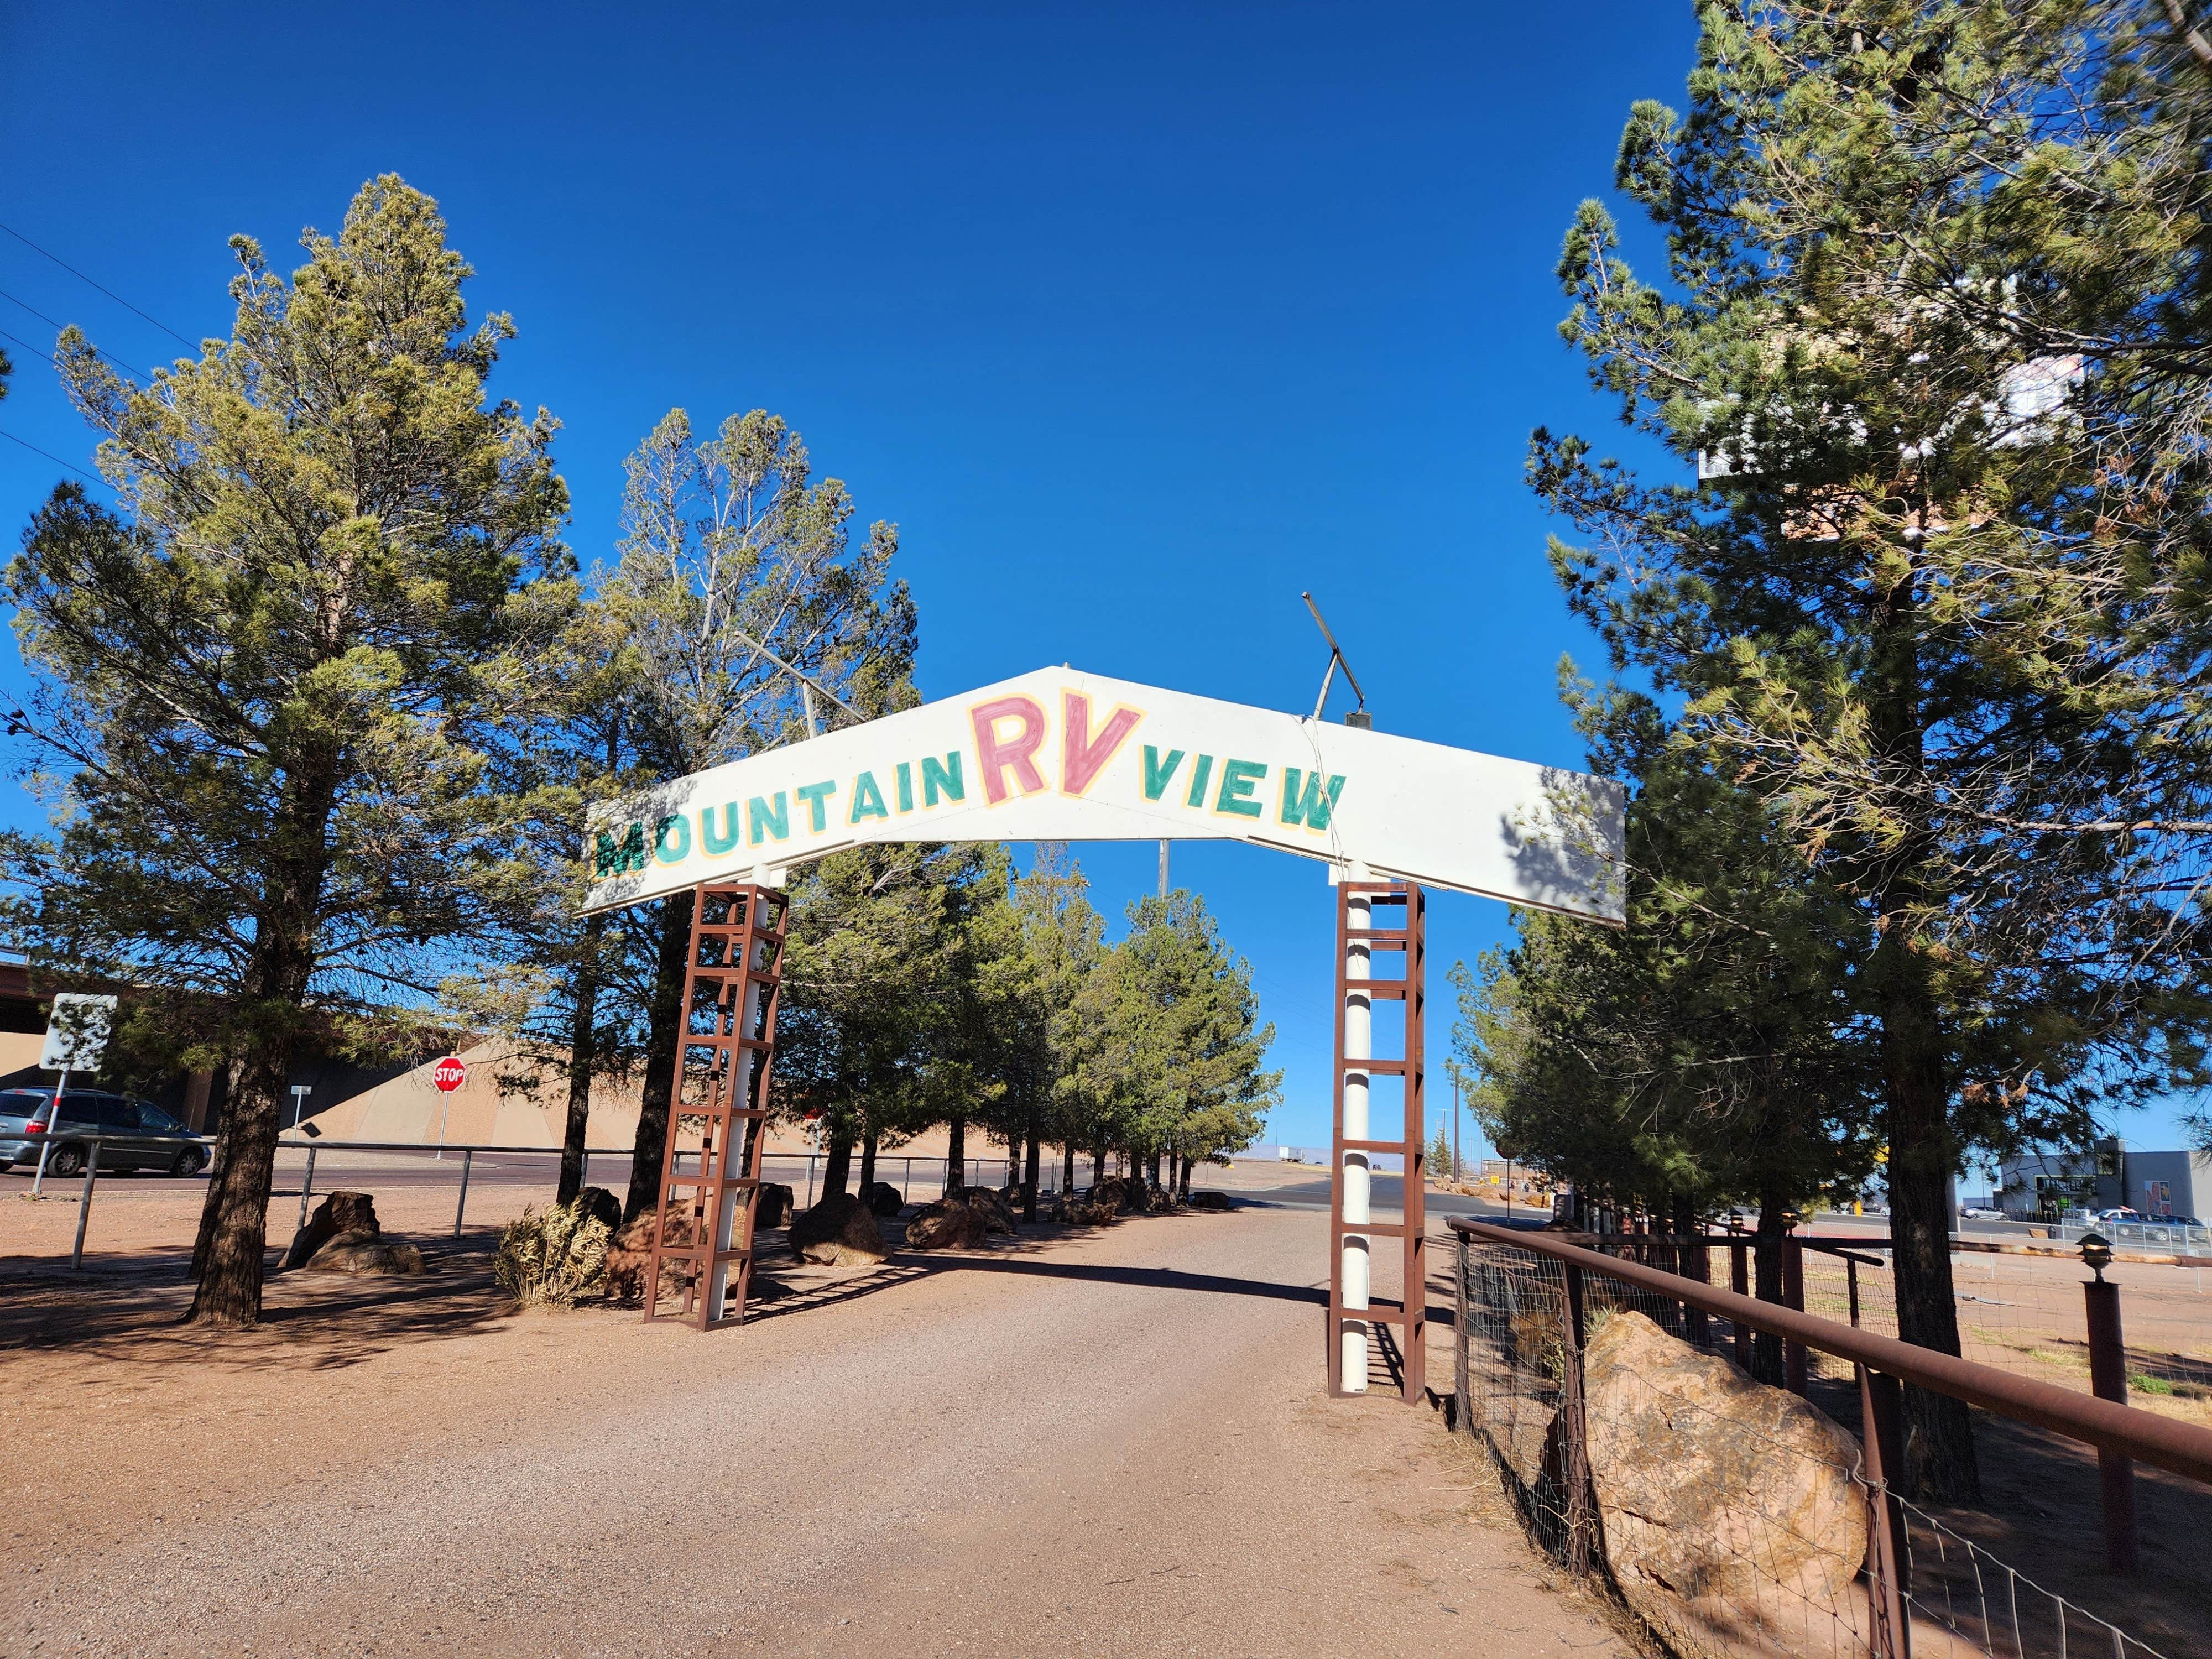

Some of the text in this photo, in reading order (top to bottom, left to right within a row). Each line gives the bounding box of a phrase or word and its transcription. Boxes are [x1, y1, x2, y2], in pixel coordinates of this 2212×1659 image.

[593, 690, 1346, 880] MOUNTAIN RV VIEW
[435, 1067, 463, 1082] STOP
